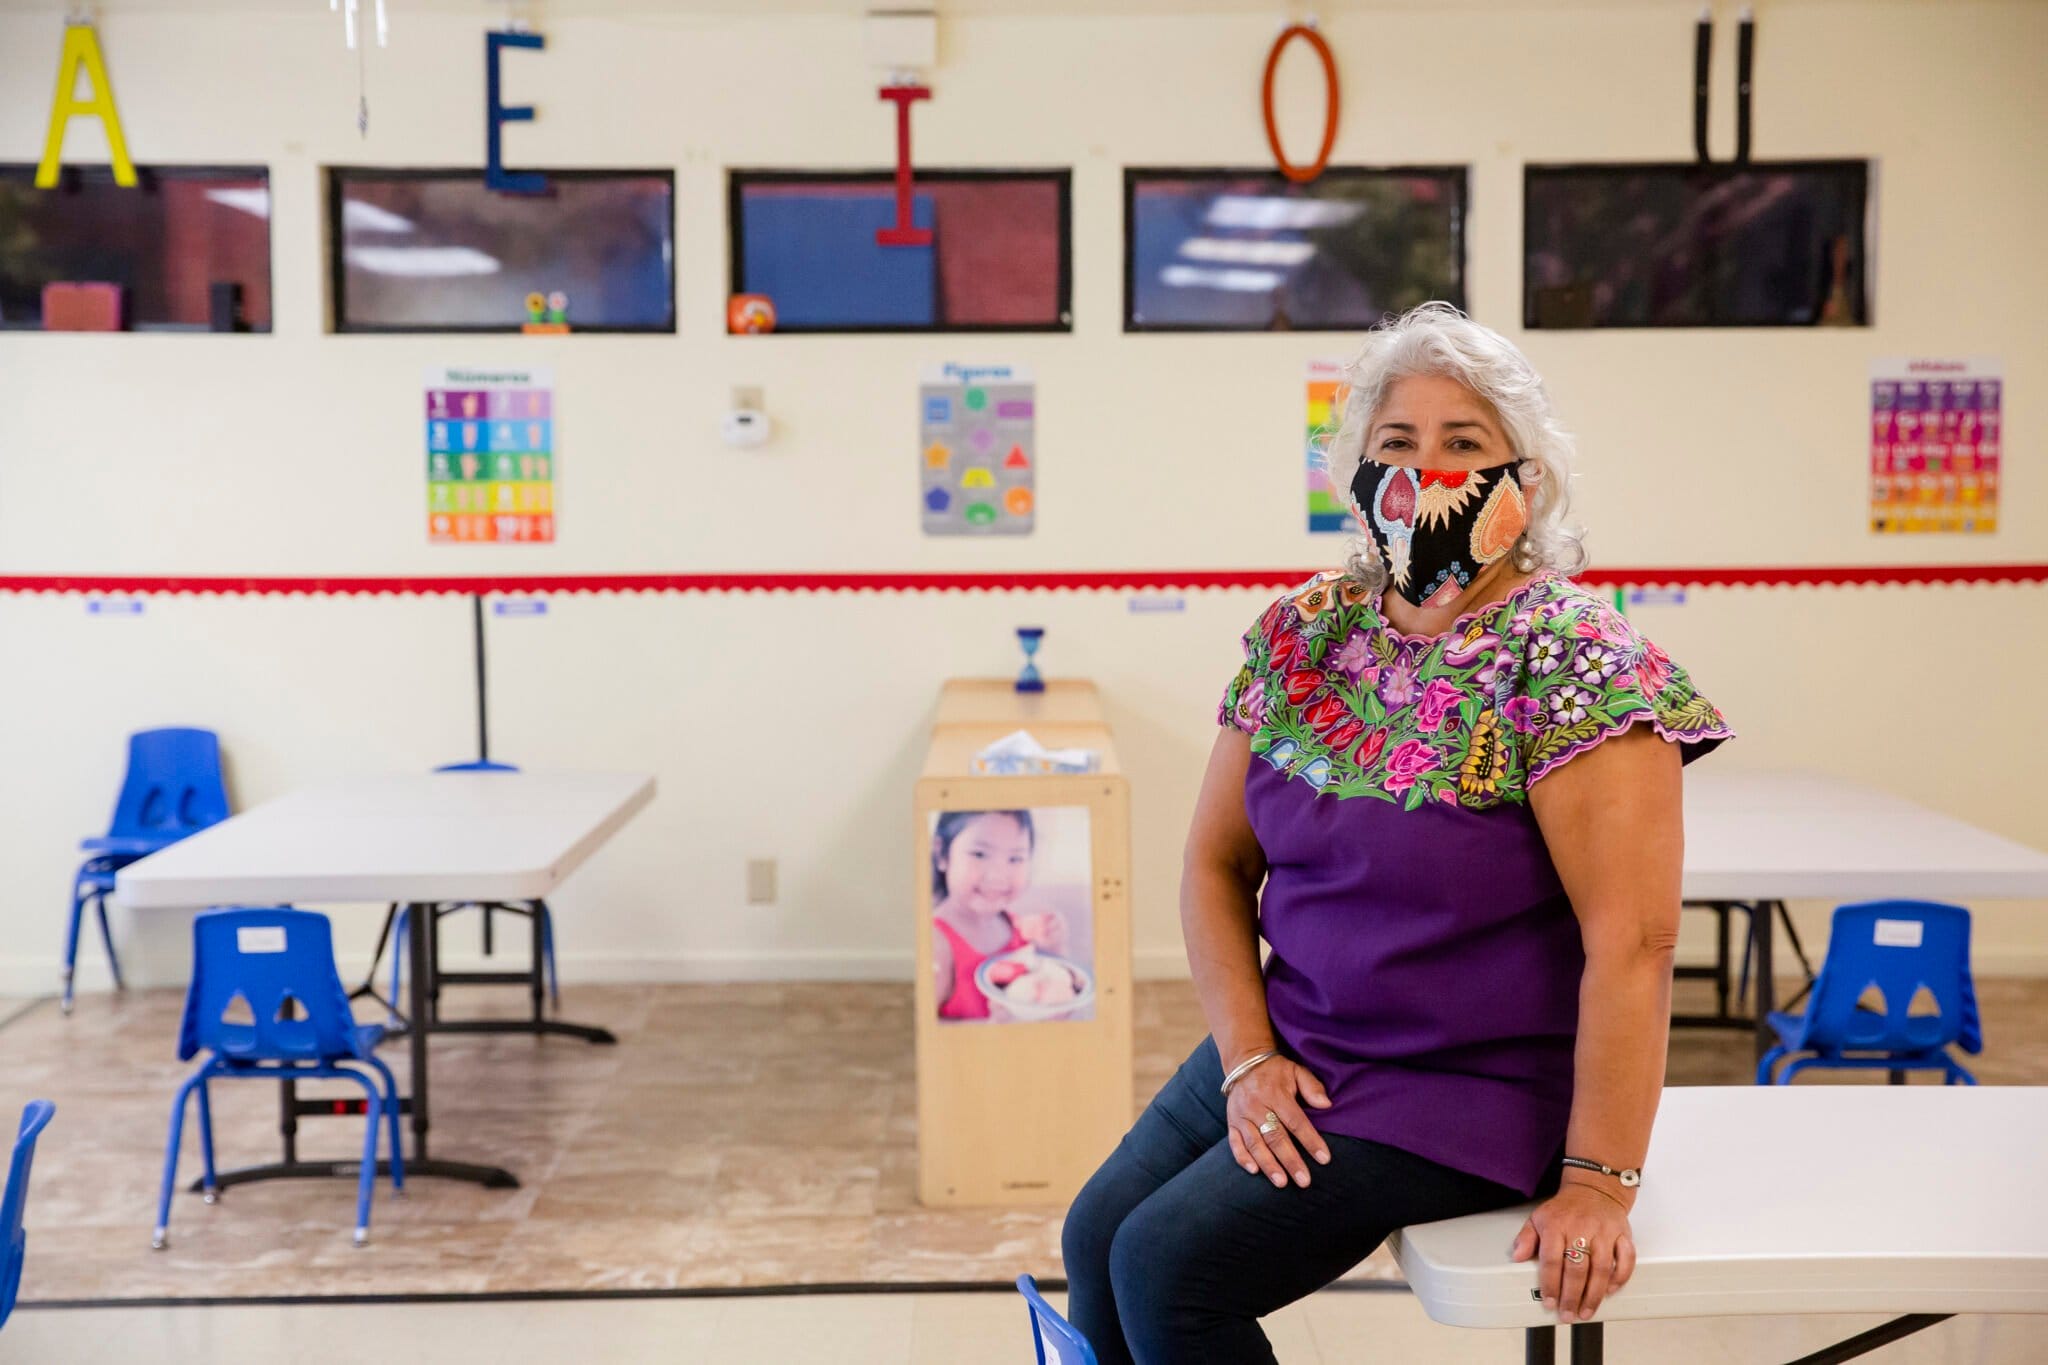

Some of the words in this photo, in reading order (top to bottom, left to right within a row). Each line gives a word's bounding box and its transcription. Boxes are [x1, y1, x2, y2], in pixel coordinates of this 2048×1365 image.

[34, 26, 138, 188] A
[485, 31, 547, 192] E
[876, 86, 933, 247] I
[1263, 25, 1341, 182] O
